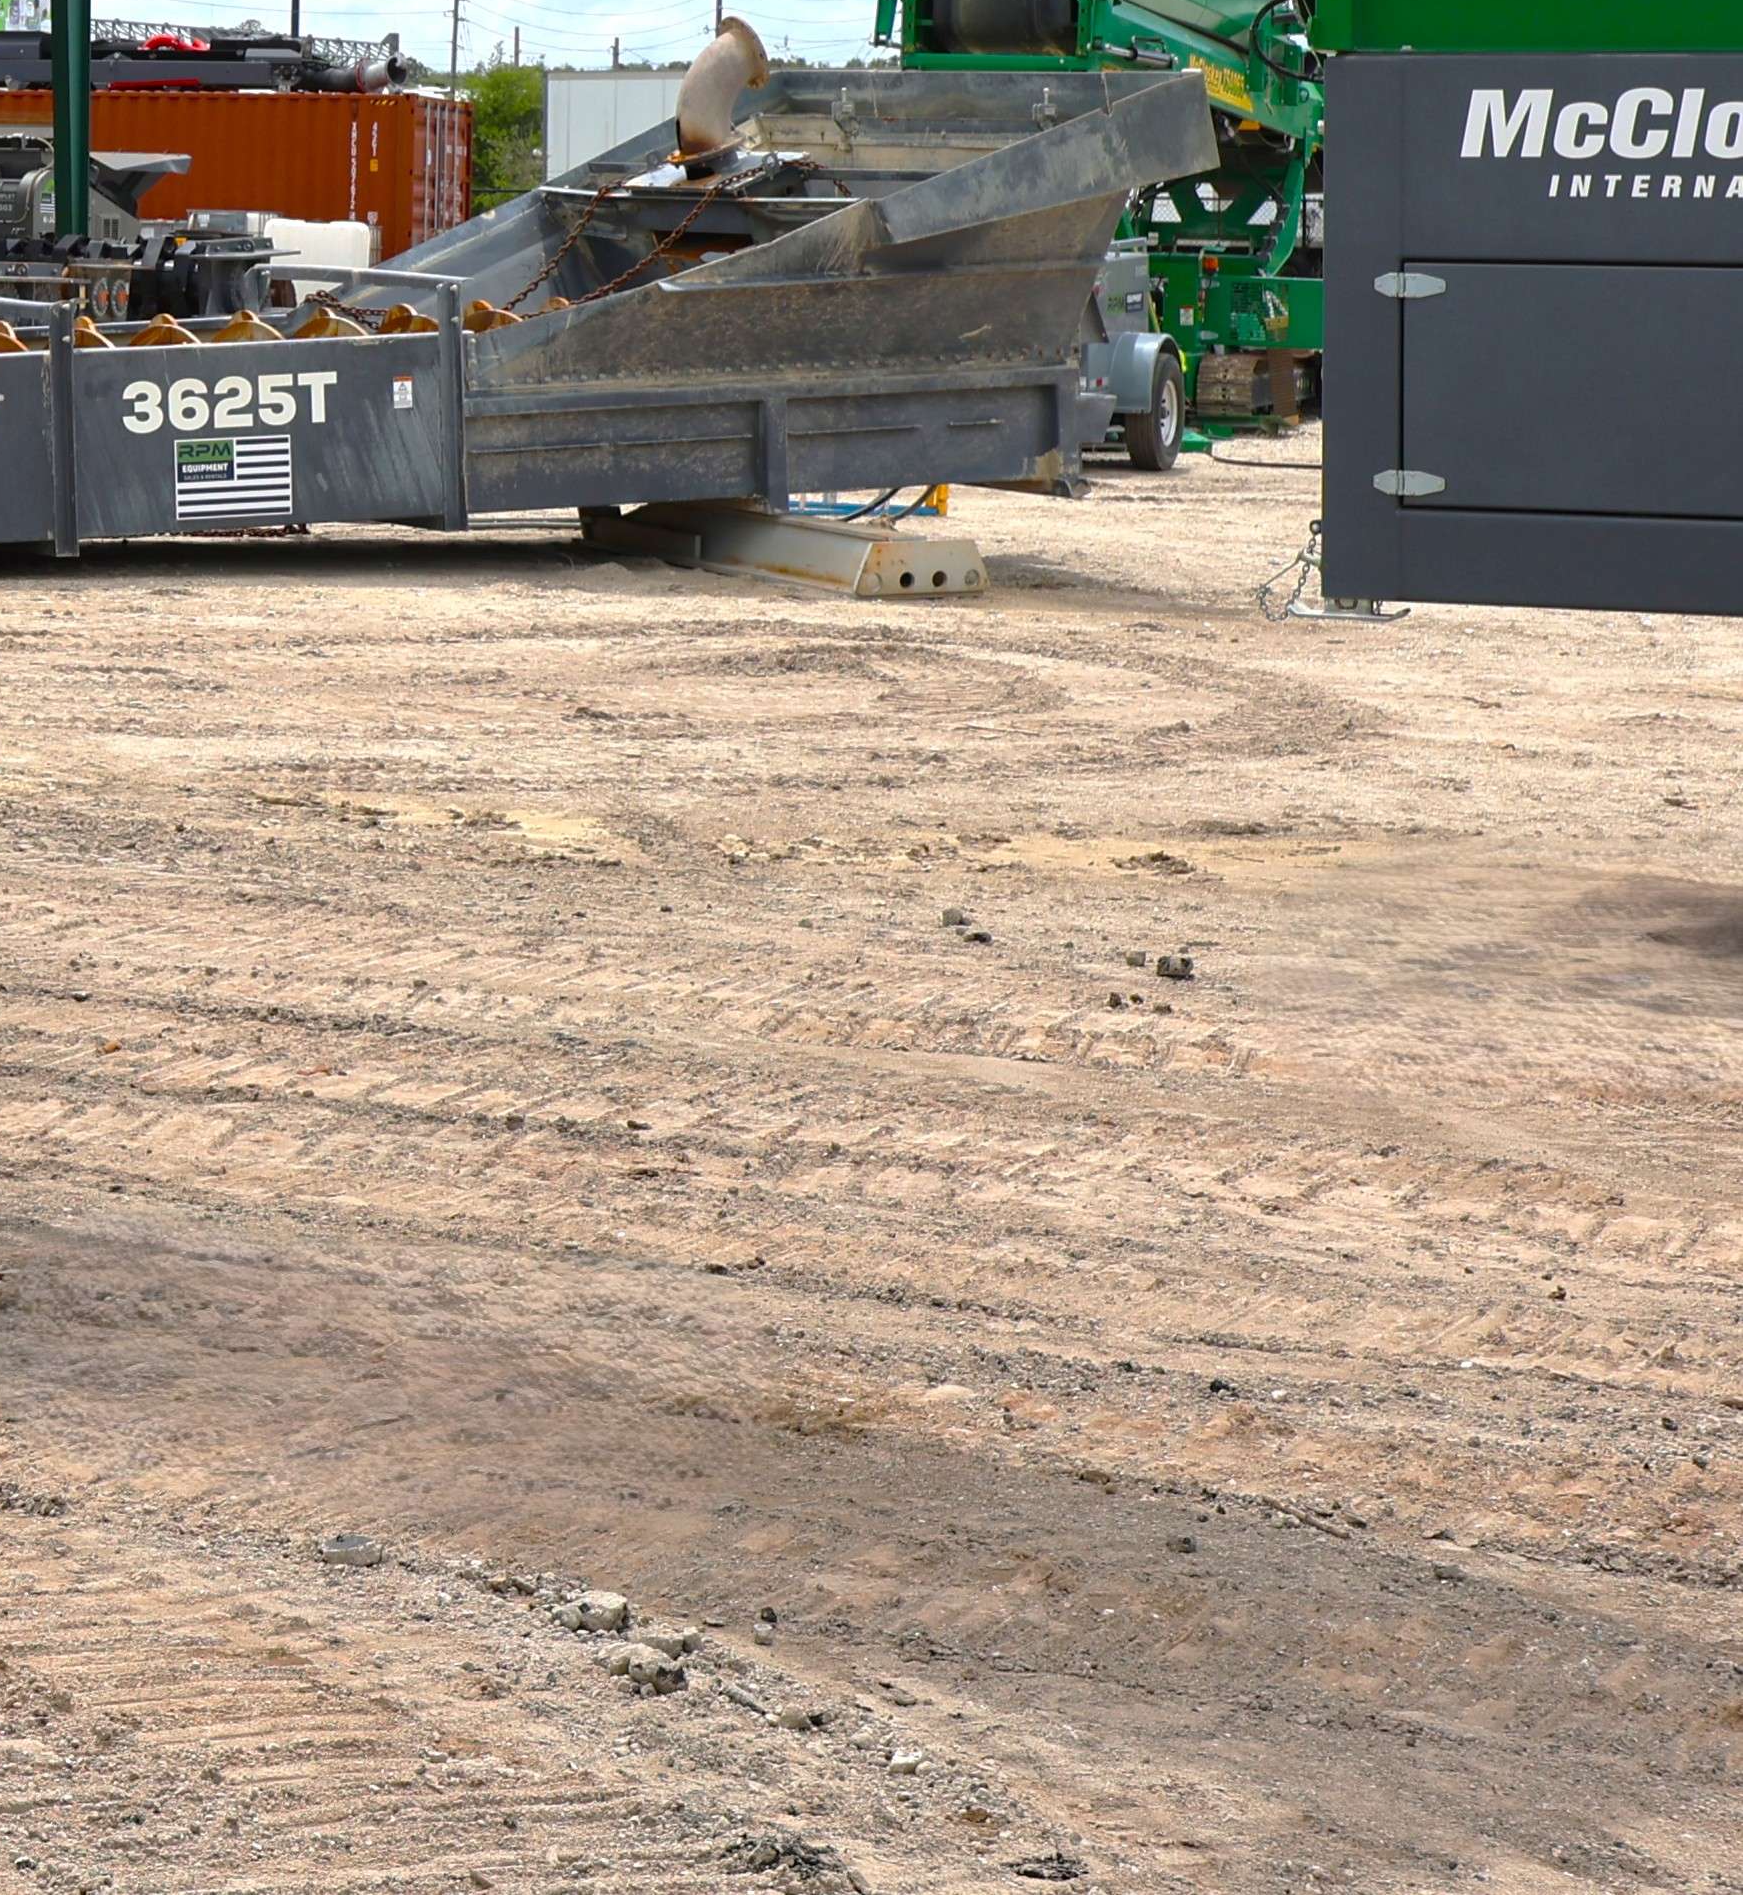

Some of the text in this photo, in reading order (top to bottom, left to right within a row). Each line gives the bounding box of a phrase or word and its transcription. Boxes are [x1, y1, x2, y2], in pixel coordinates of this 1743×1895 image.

[122, 371, 338, 434] 3625T
[179, 443, 231, 458] RPM
[182, 462, 228, 473] EQUIPMENT
